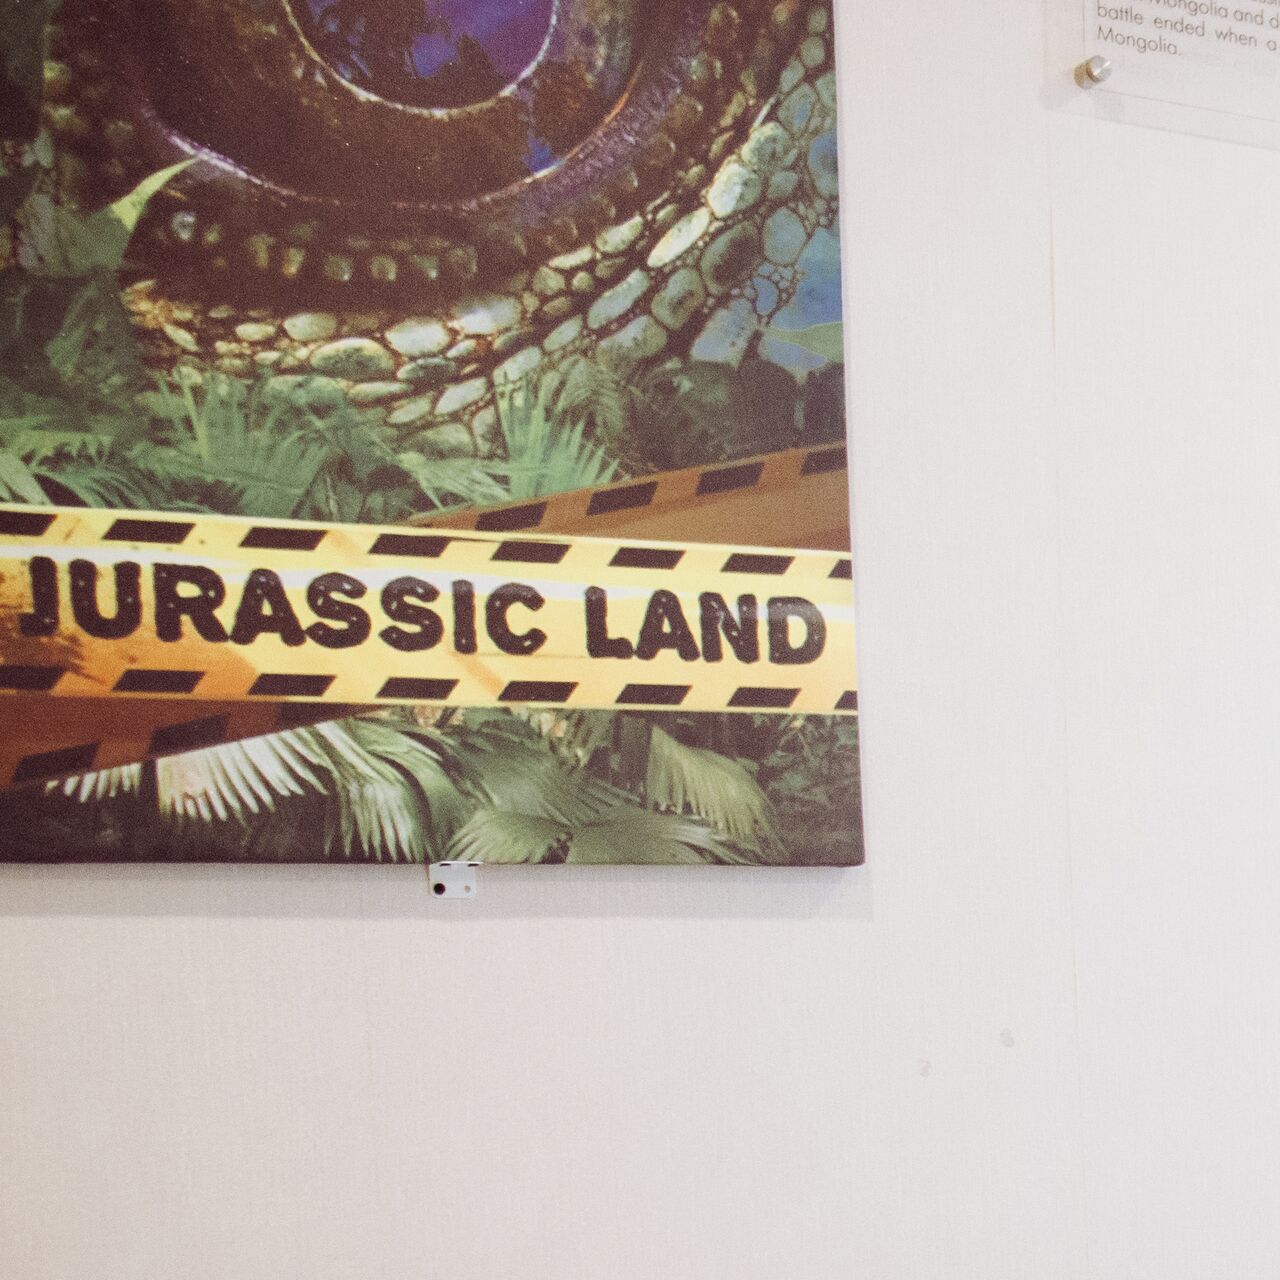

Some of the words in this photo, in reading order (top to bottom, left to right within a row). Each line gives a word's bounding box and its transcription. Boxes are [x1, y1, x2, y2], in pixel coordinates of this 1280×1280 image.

[1097, 2, 1144, 25] battle
[1153, 16, 1205, 37] ended
[1215, 27, 1257, 48] when
[1266, 40, 1277, 52] a
[1233, 9, 1264, 25] and
[1097, 25, 1182, 57] Mongolia.
[20, 555, 548, 656] JURASSIC
[584, 585, 828, 666] LAND
